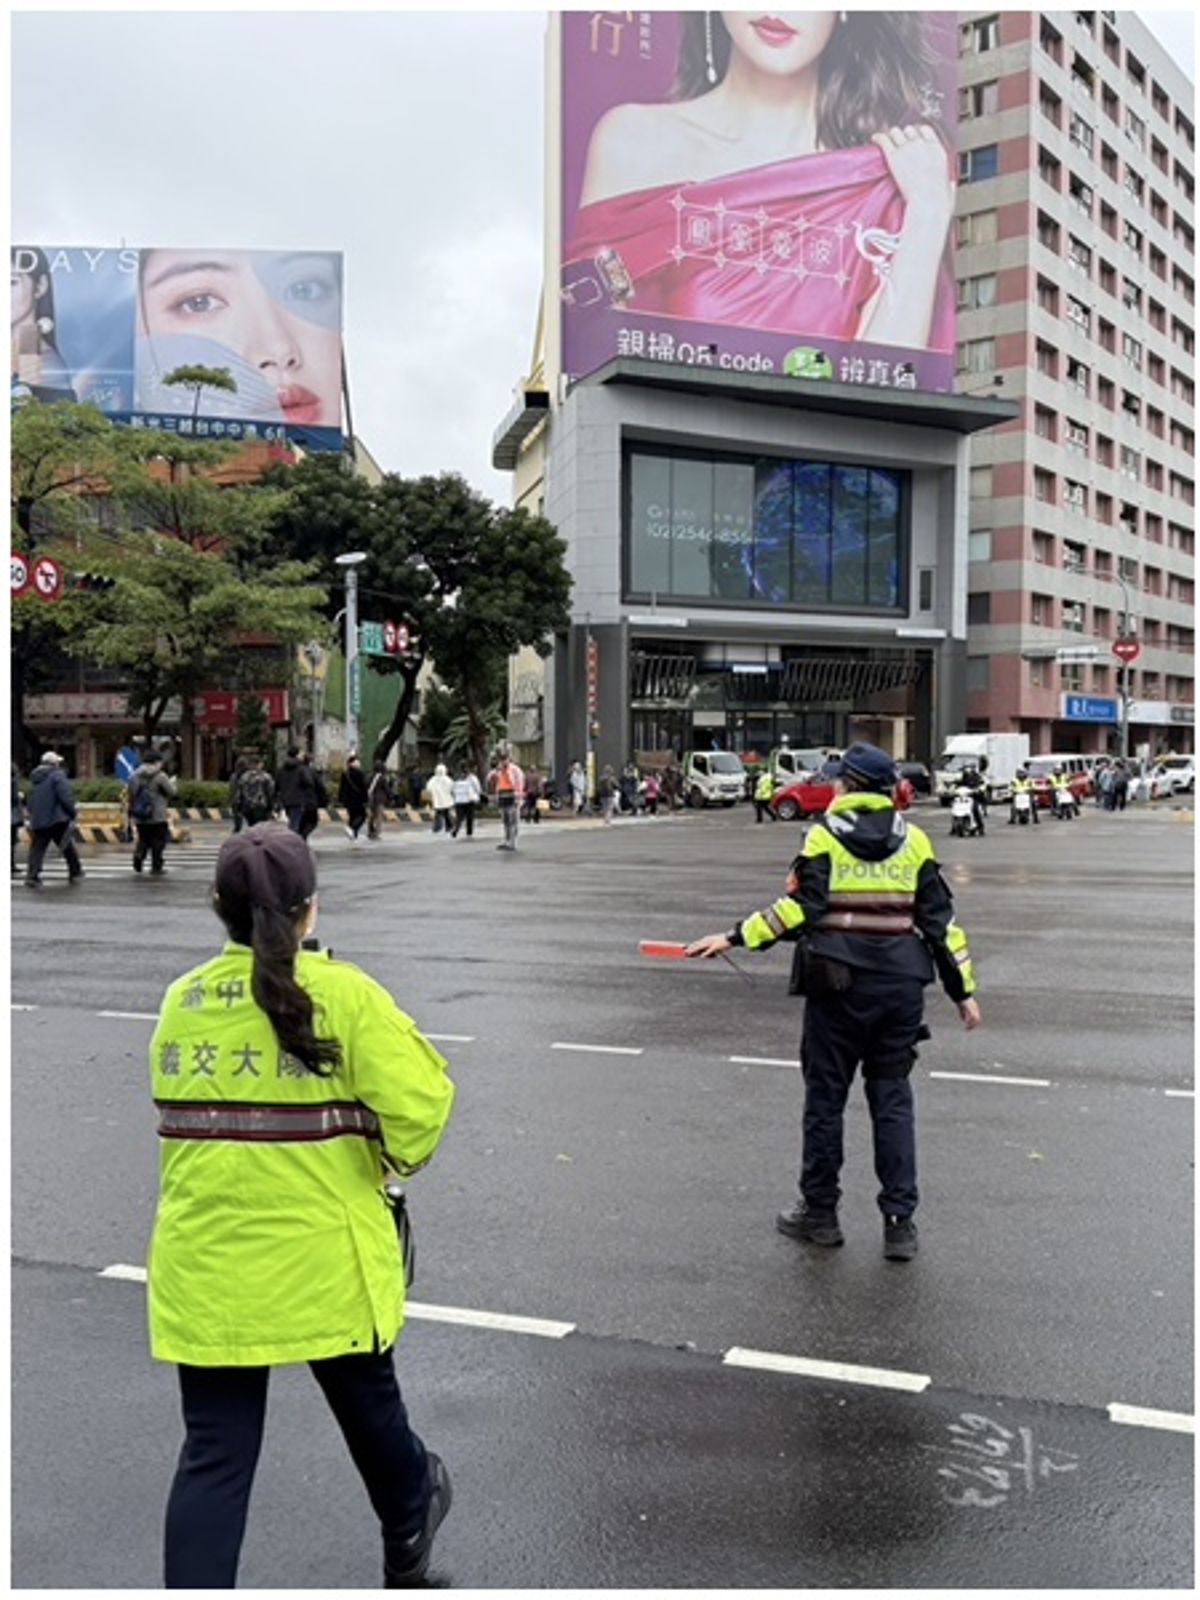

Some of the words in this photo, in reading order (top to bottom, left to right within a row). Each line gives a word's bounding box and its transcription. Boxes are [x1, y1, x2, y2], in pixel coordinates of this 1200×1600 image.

[14, 249, 140, 274] DAYS
[718, 353, 774, 372] code
[836, 860, 914, 883] POLICE
